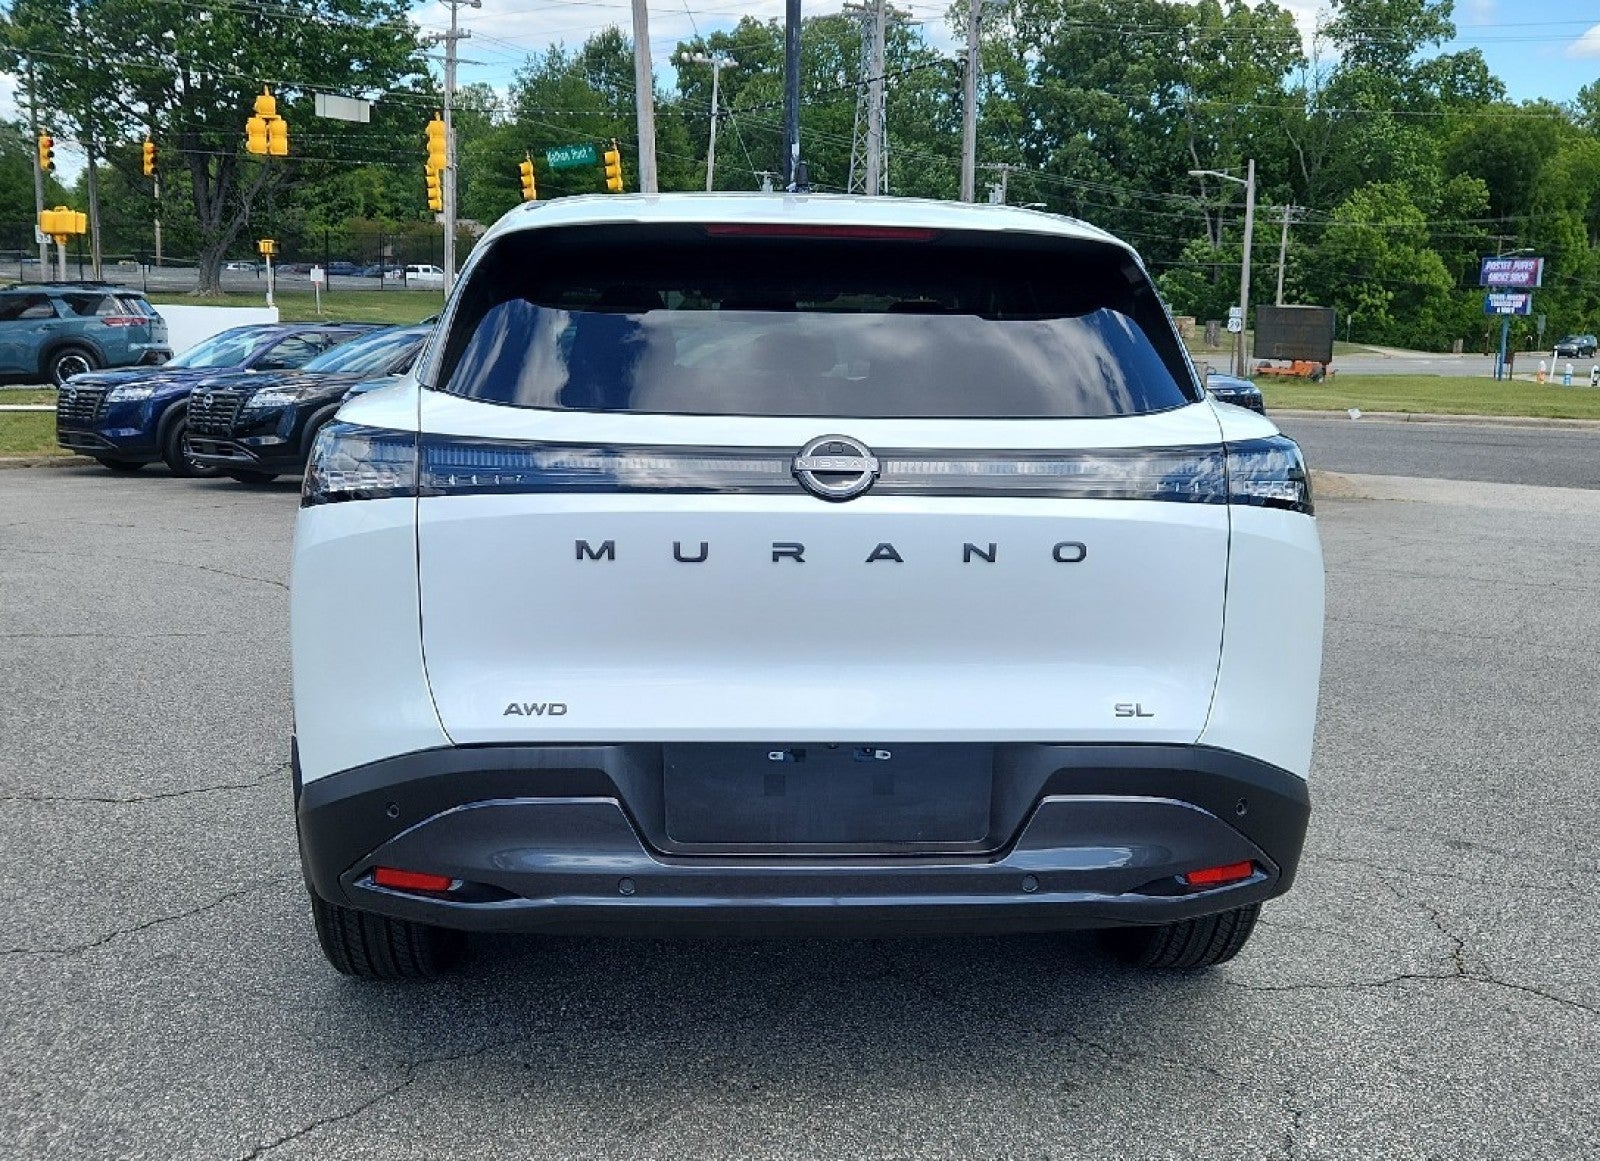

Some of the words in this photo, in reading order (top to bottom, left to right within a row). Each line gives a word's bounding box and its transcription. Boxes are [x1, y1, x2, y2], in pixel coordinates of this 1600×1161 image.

[1228, 319, 1240, 330] 29
[797, 459, 876, 469] NISSAN
[575, 539, 1087, 562] MURANO
[503, 702, 567, 715] AWD
[1114, 703, 1154, 717] SL
